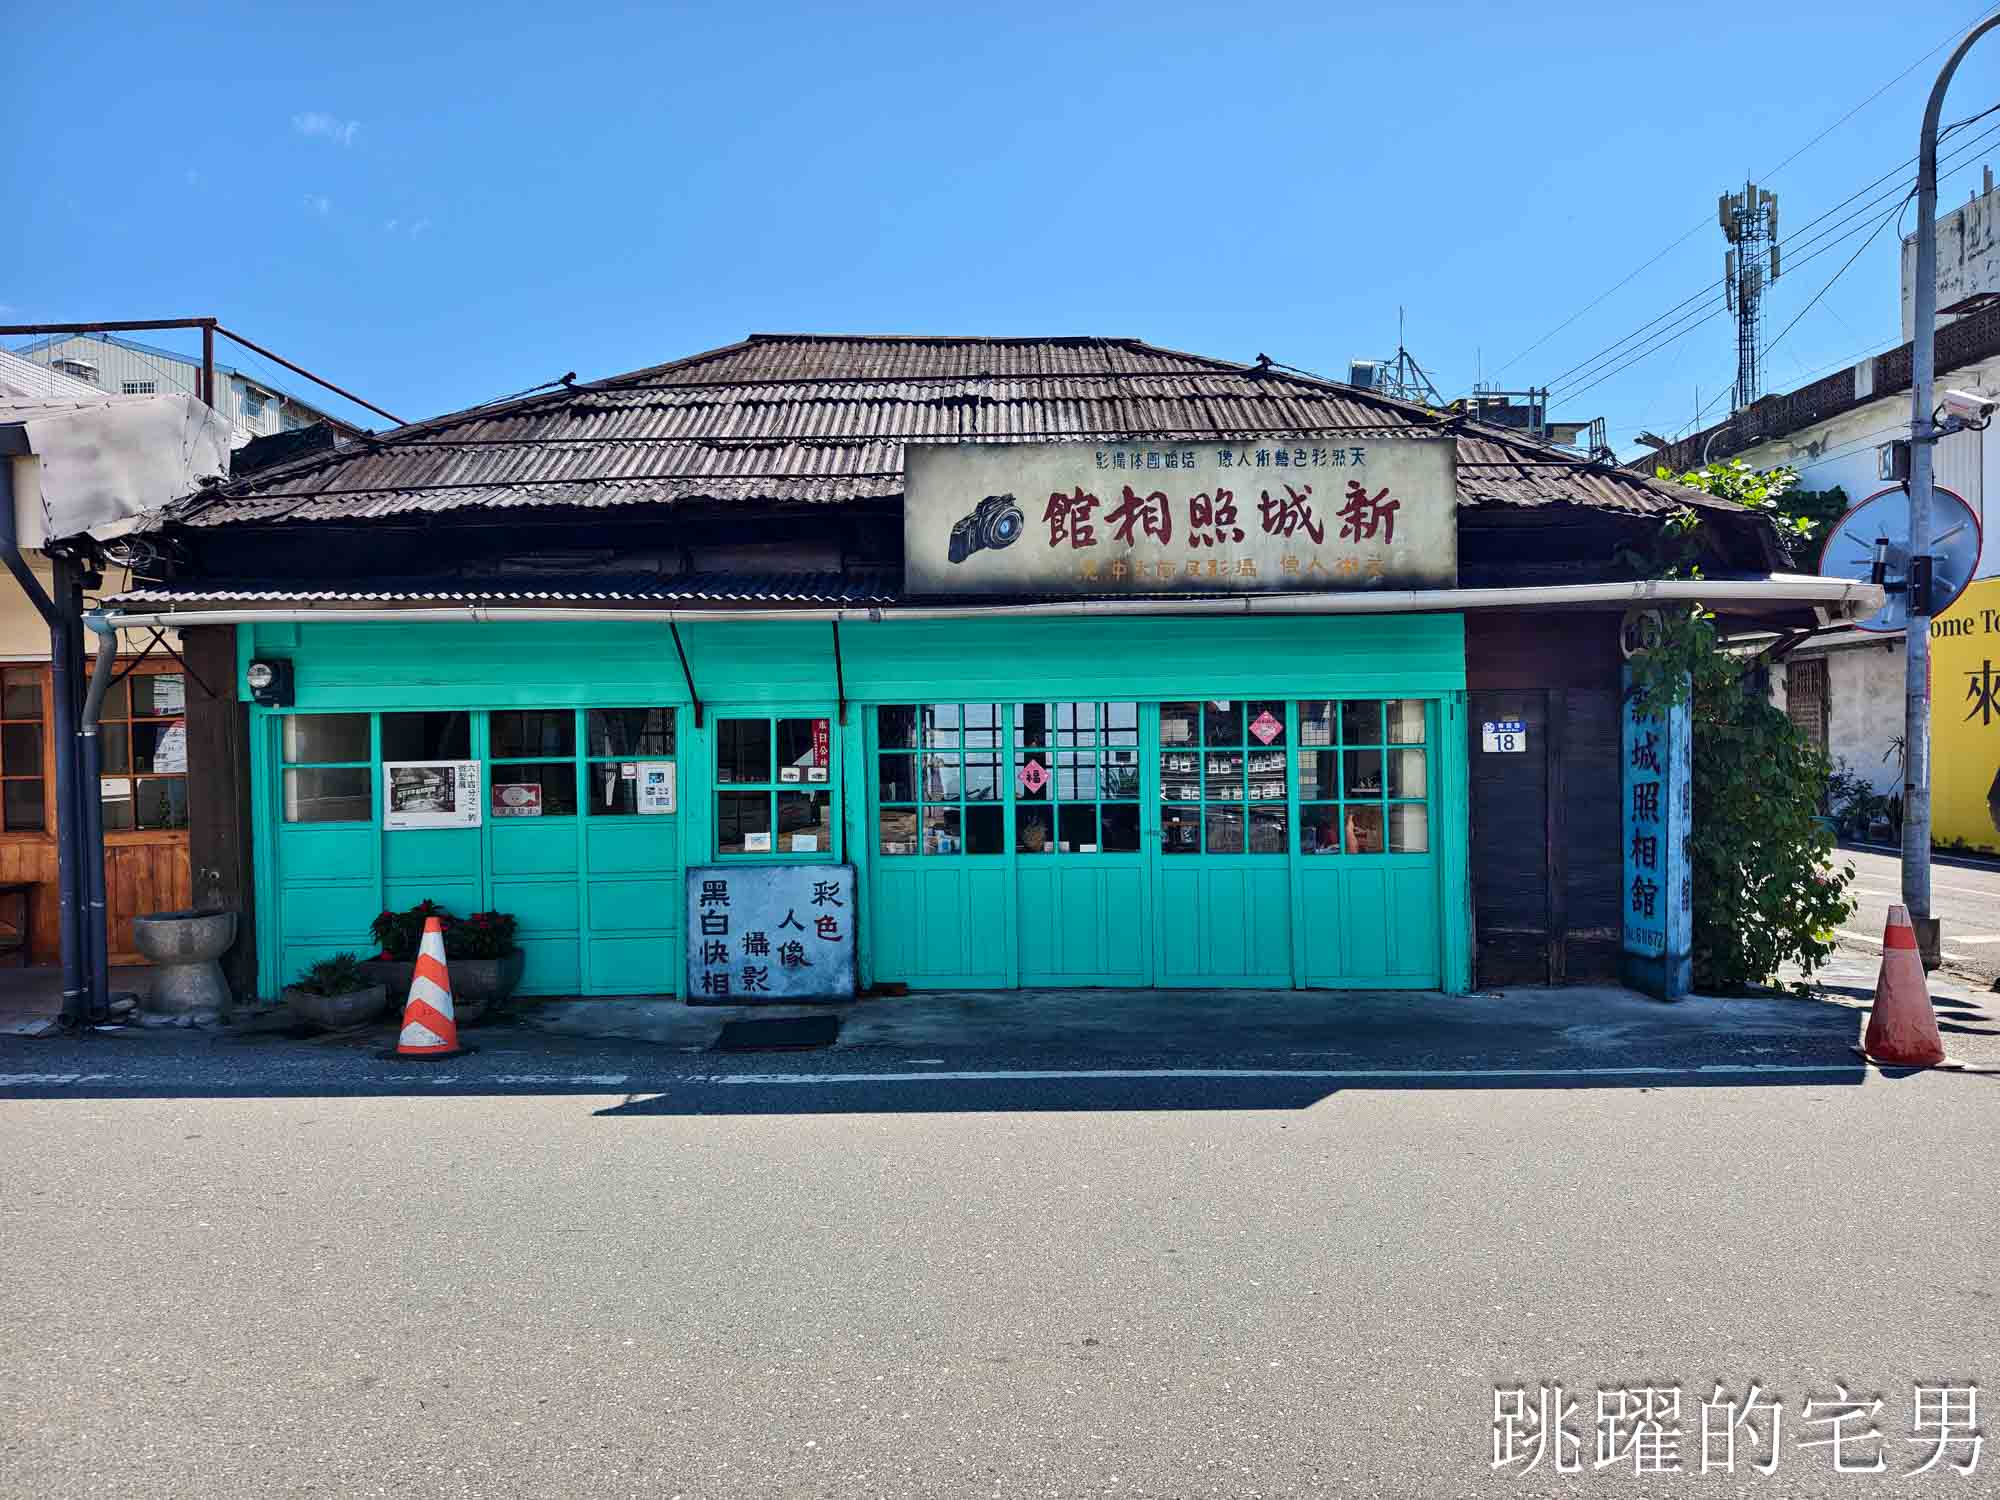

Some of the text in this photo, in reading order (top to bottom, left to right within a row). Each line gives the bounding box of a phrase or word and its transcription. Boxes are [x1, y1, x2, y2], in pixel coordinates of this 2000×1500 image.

[1042, 481, 1400, 549] 新城照相館
[1494, 734, 1514, 751] 18
[1026, 769, 1041, 784] 福
[699, 879, 731, 995] 黑白快相
[776, 908, 814, 968] 人像
[811, 880, 844, 942] 彩色
[742, 931, 771, 993] 攝影
